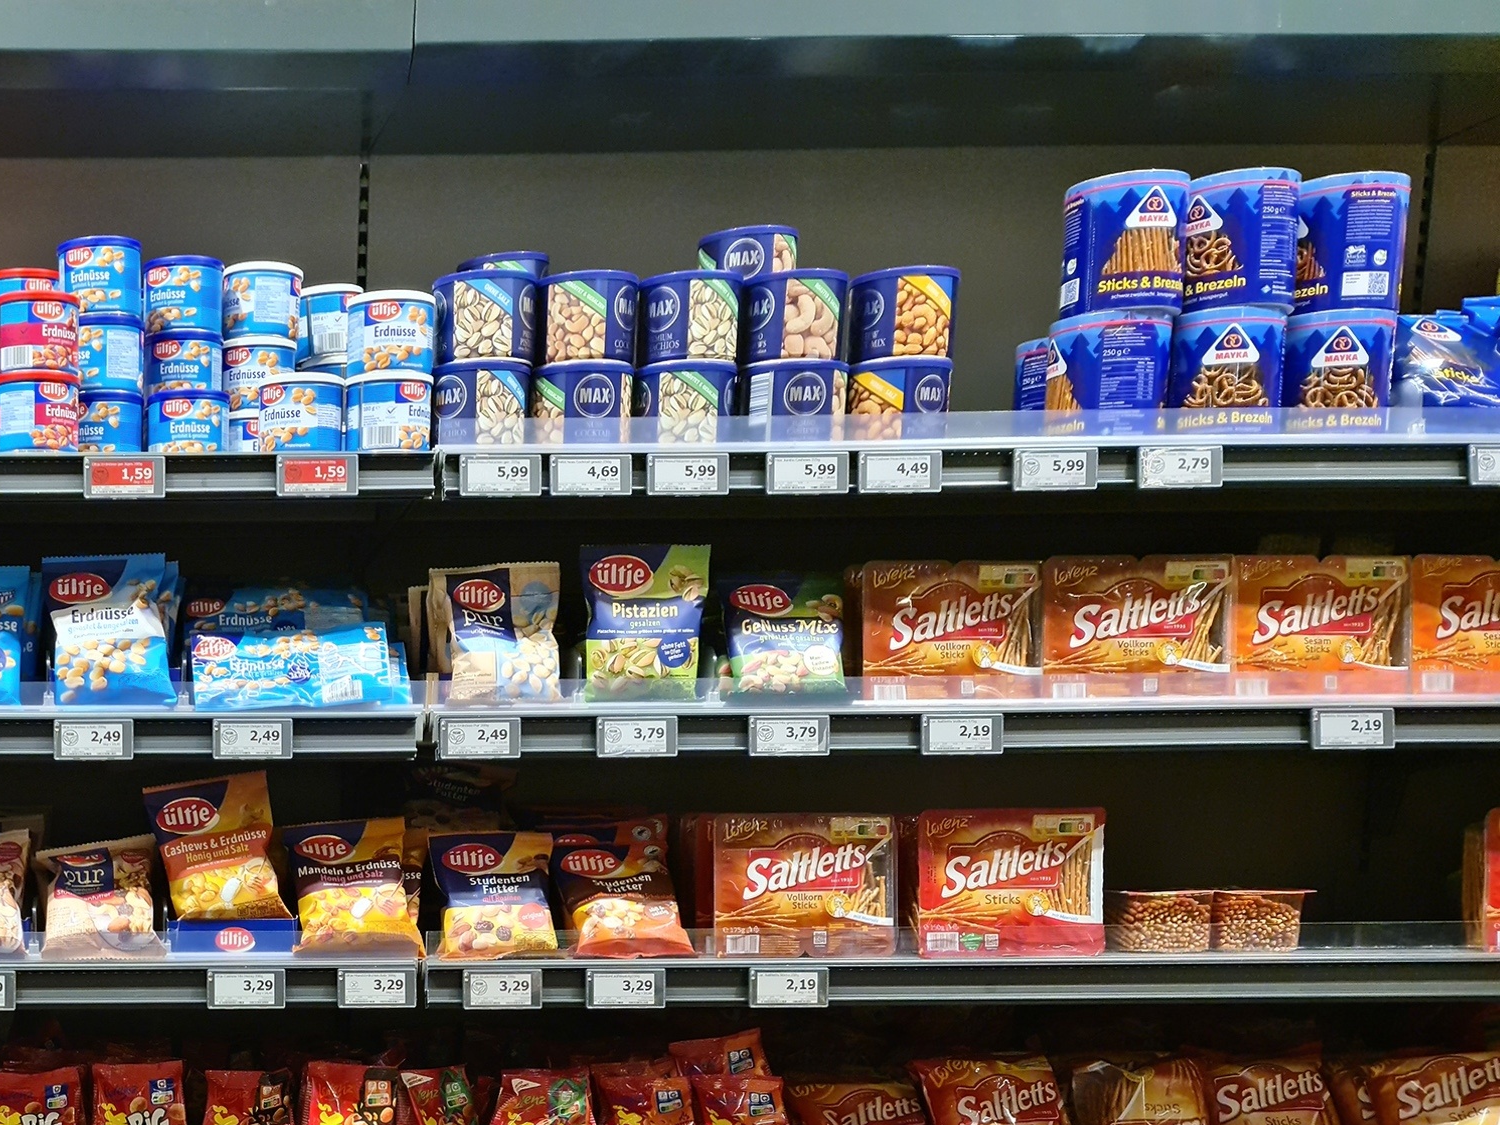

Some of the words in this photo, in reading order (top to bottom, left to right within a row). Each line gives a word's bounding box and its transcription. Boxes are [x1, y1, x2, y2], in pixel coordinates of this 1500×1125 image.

[1139, 214, 1169, 222] MAYKA
[729, 248, 760, 268] MAX
[71, 268, 111, 283] Erdnüsse
[1098, 276, 1142, 294] Sticks
[1145, 278, 1152, 288] &
[374, 325, 417, 339] Erdnüsse
[1215, 349, 1248, 360] MAYKA
[579, 385, 609, 404] MAX
[169, 420, 210, 435] Erdnüsse
[1177, 415, 1213, 429] Sticks
[1216, 413, 1227, 426] &
[1231, 411, 1273, 426] Brezeln
[804, 463, 836, 478] 5,99
[1052, 459, 1085, 474] 5,99
[1178, 457, 1210, 472] 2,79
[497, 465, 529, 480] 5,99
[587, 465, 619, 480] 4,69
[596, 564, 645, 586] ültje
[56, 579, 104, 599] ültje
[459, 586, 500, 607] ültje
[737, 591, 784, 610] ültje
[463, 609, 504, 627] pur
[612, 603, 679, 619] Pistazien
[1252, 590, 1380, 644] Saltletts
[890, 588, 1014, 650] Saltletts
[933, 641, 973, 652] Vollkorn
[786, 726, 817, 740] 3,79
[1350, 719, 1382, 733] 2,19
[250, 730, 280, 744] 2,49
[477, 728, 508, 743] 2,49
[162, 802, 210, 828] ültje
[164, 838, 208, 856] Cashews
[221, 829, 267, 846] Erdnüsse
[449, 850, 496, 870] ültje
[568, 854, 616, 872] ültje
[743, 841, 870, 900] Saltletts
[941, 840, 1068, 899] Saltletts
[469, 874, 530, 885] Studenten
[482, 883, 519, 894] Futter
[984, 893, 1021, 905] Sticks
[219, 931, 250, 949] ültje
[373, 979, 404, 992] 3,29
[499, 980, 530, 994] 3,29
[786, 978, 816, 990] 2,19
